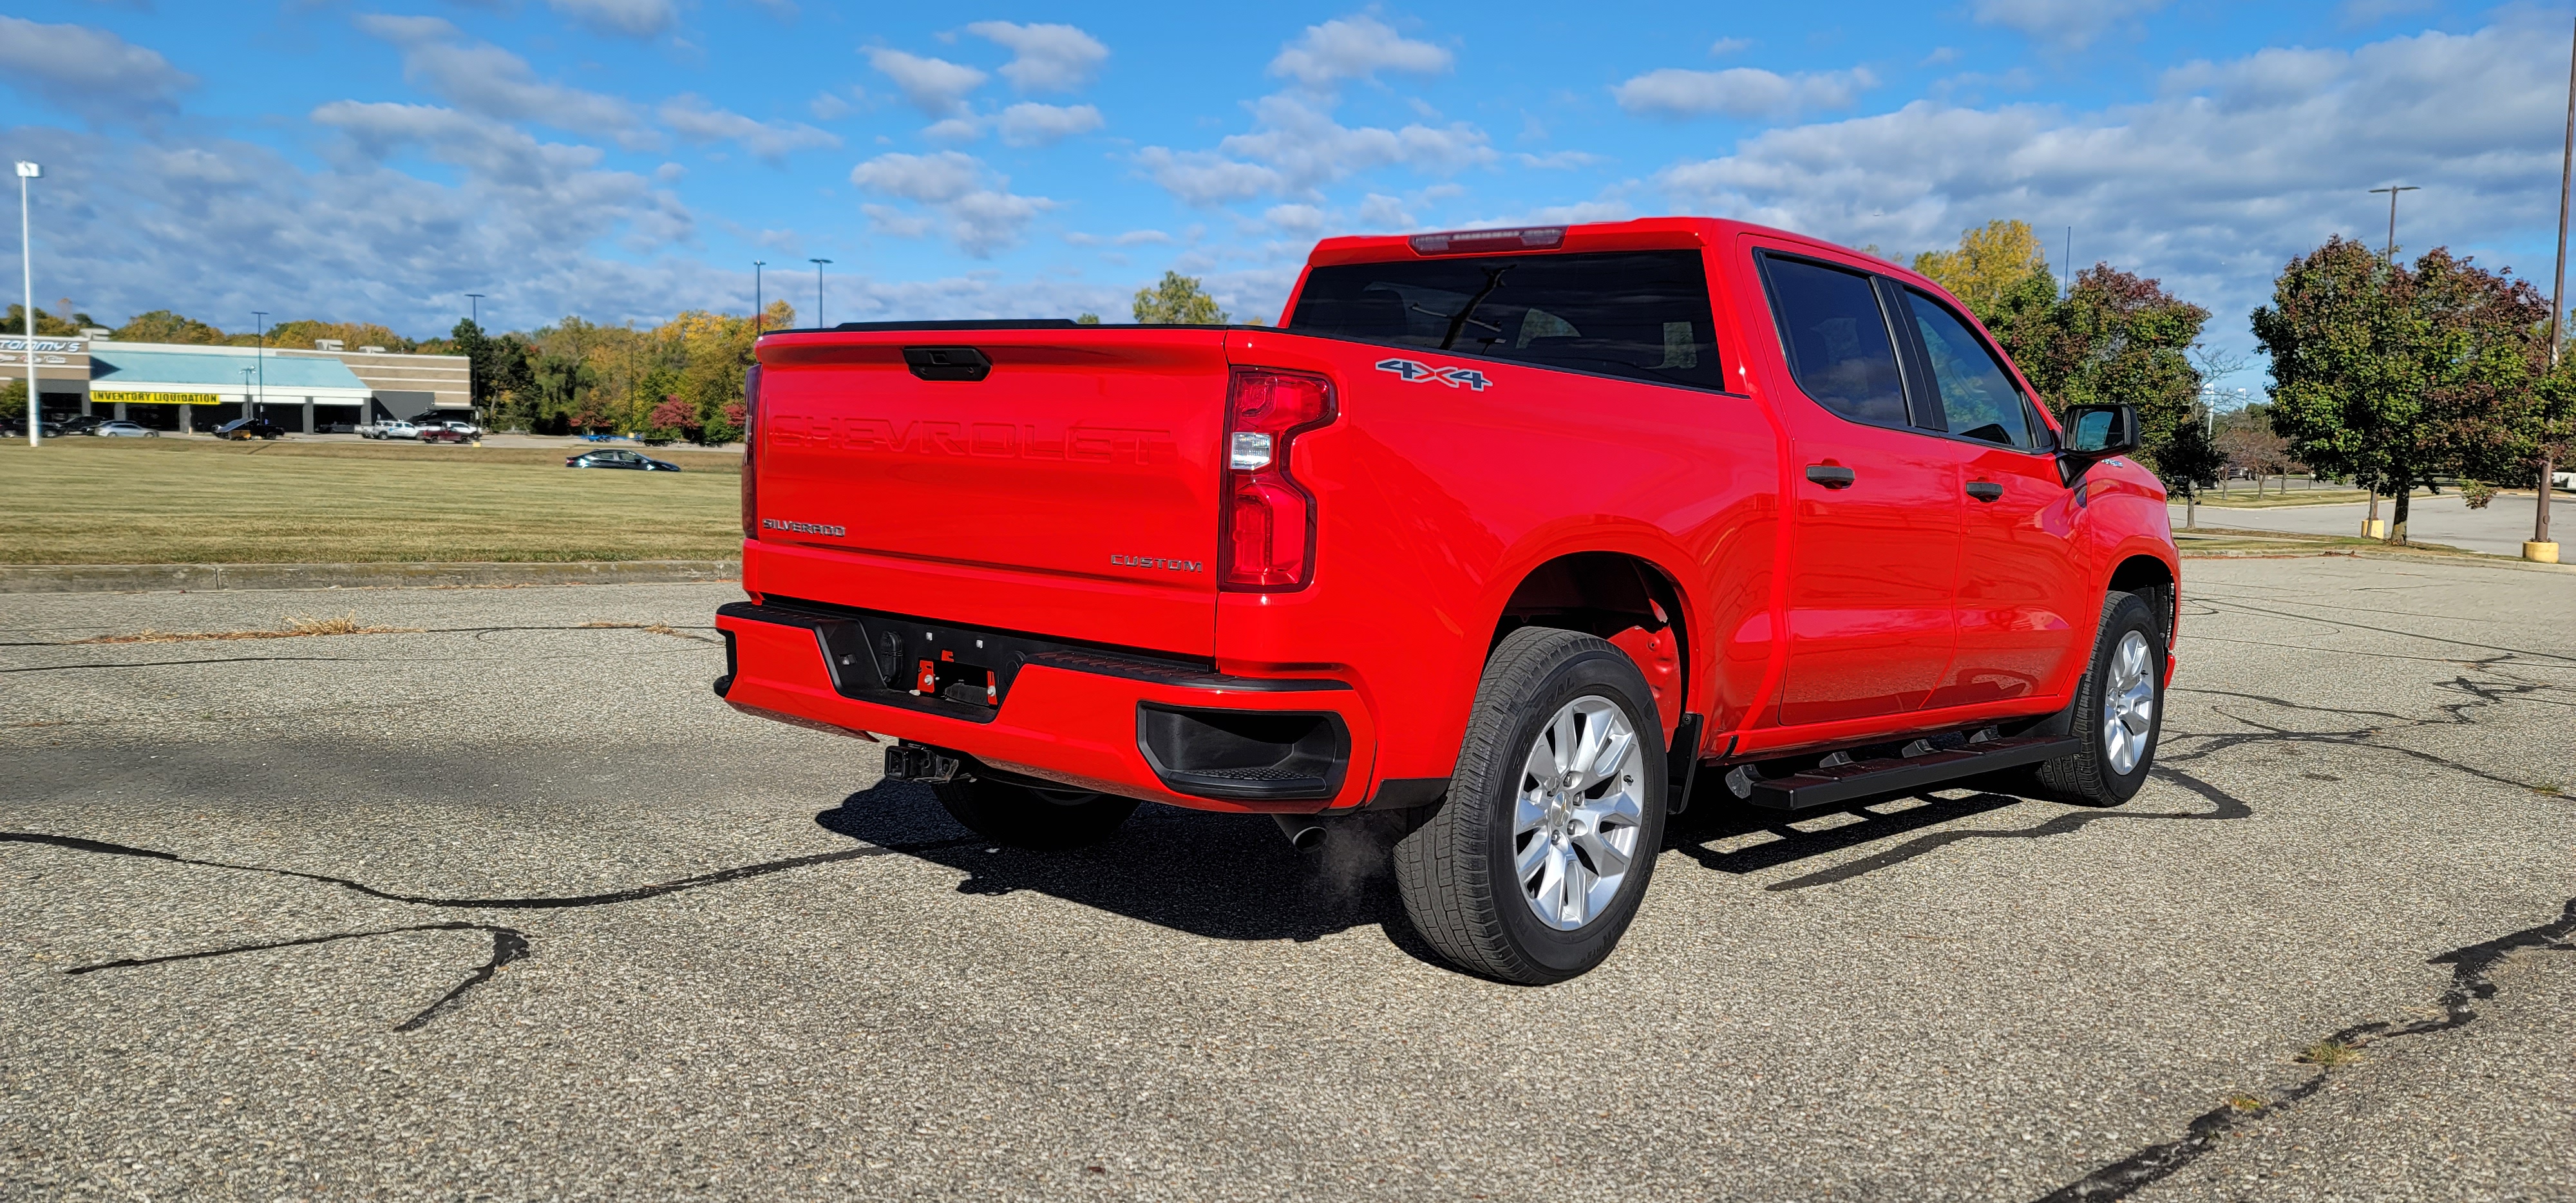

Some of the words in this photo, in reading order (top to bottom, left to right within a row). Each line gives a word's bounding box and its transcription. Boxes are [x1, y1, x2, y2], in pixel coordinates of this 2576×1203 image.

[94, 392, 151, 401] INVENTORY
[154, 393, 217, 403] LIQUIDATION
[773, 415, 1171, 466] CHEVROLET
[762, 518, 846, 537] SILVERADO
[1111, 554, 1202, 573] CUSTOM
